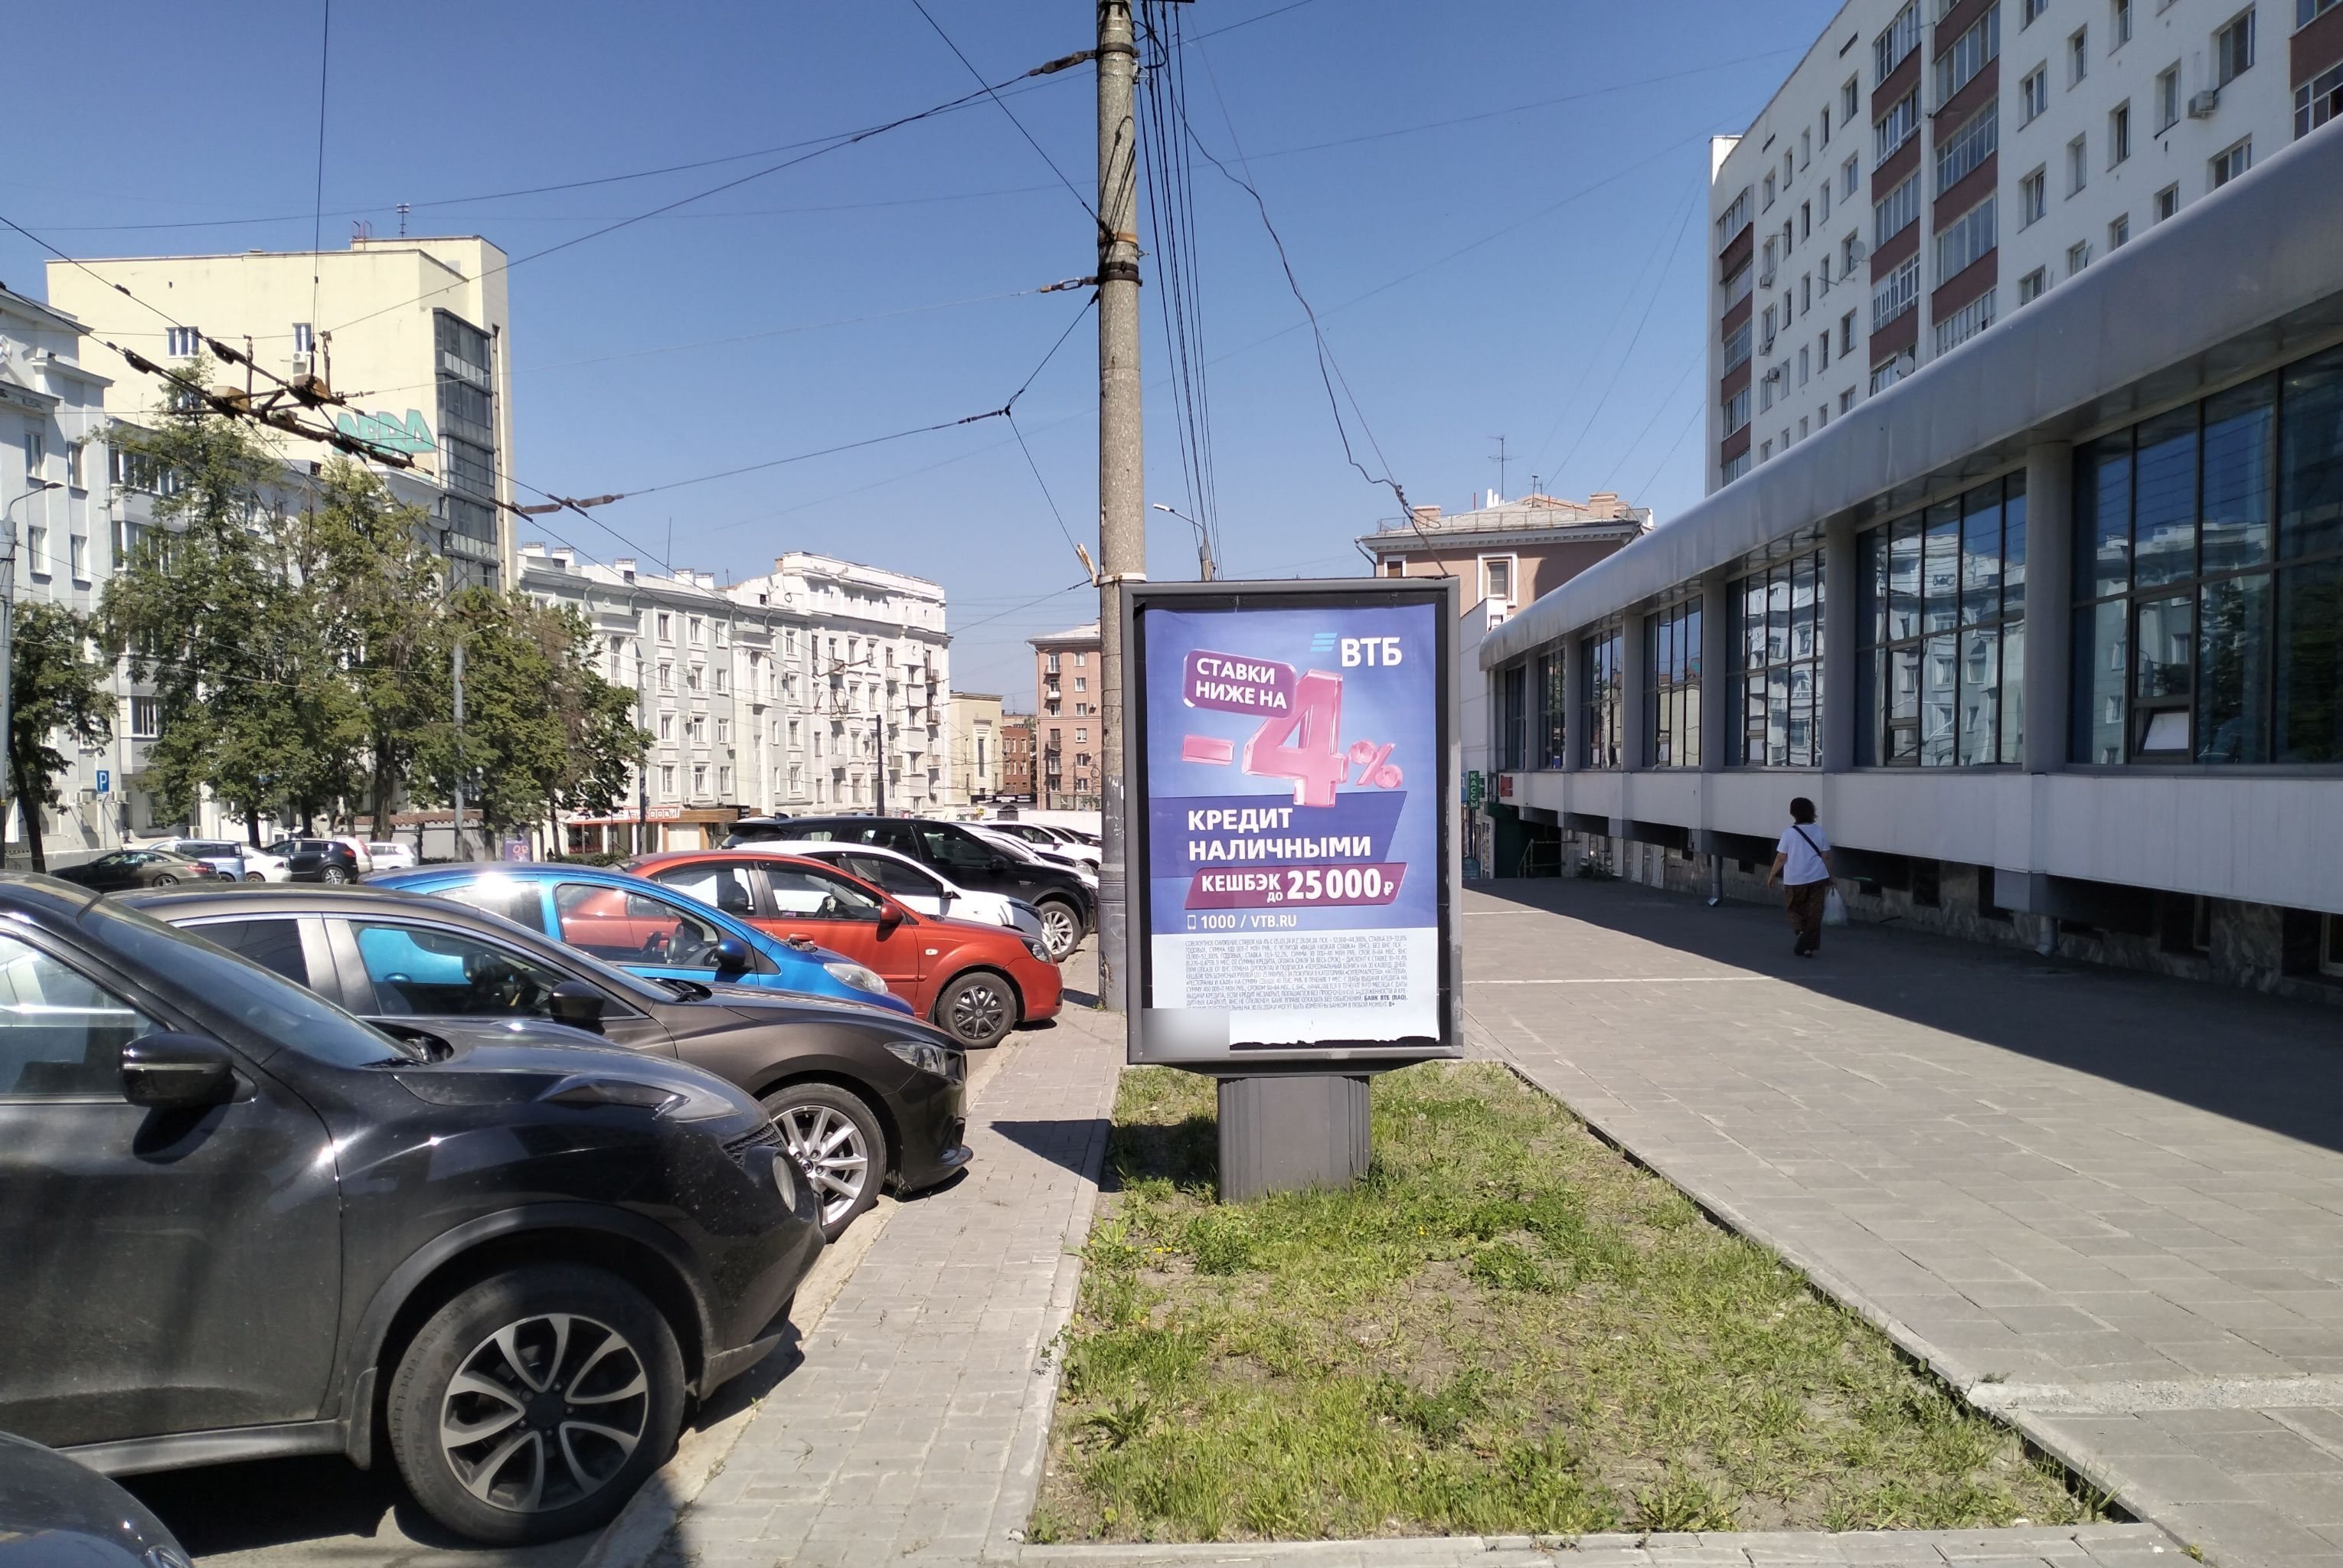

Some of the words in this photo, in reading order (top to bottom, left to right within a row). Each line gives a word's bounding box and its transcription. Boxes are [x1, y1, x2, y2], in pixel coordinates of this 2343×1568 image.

[1341, 637, 1403, 667] ВТБ
[1196, 658, 1276, 684] СТАВКИ
[1195, 680, 1255, 704] НИЖЕ
[1260, 689, 1287, 709] НА
[100, 772, 107, 790] P
[1470, 773, 1479, 808] КАССЫ
[1188, 808, 1293, 834] КРЕДИТ
[1188, 836, 1371, 861] НАЛИЧНЫМИ
[1201, 874, 1281, 892] КЕШБЭК
[1266, 890, 1283, 903] ДО
[1201, 914, 1236, 929] 1000
[1250, 914, 1297, 929] VTB.RU
